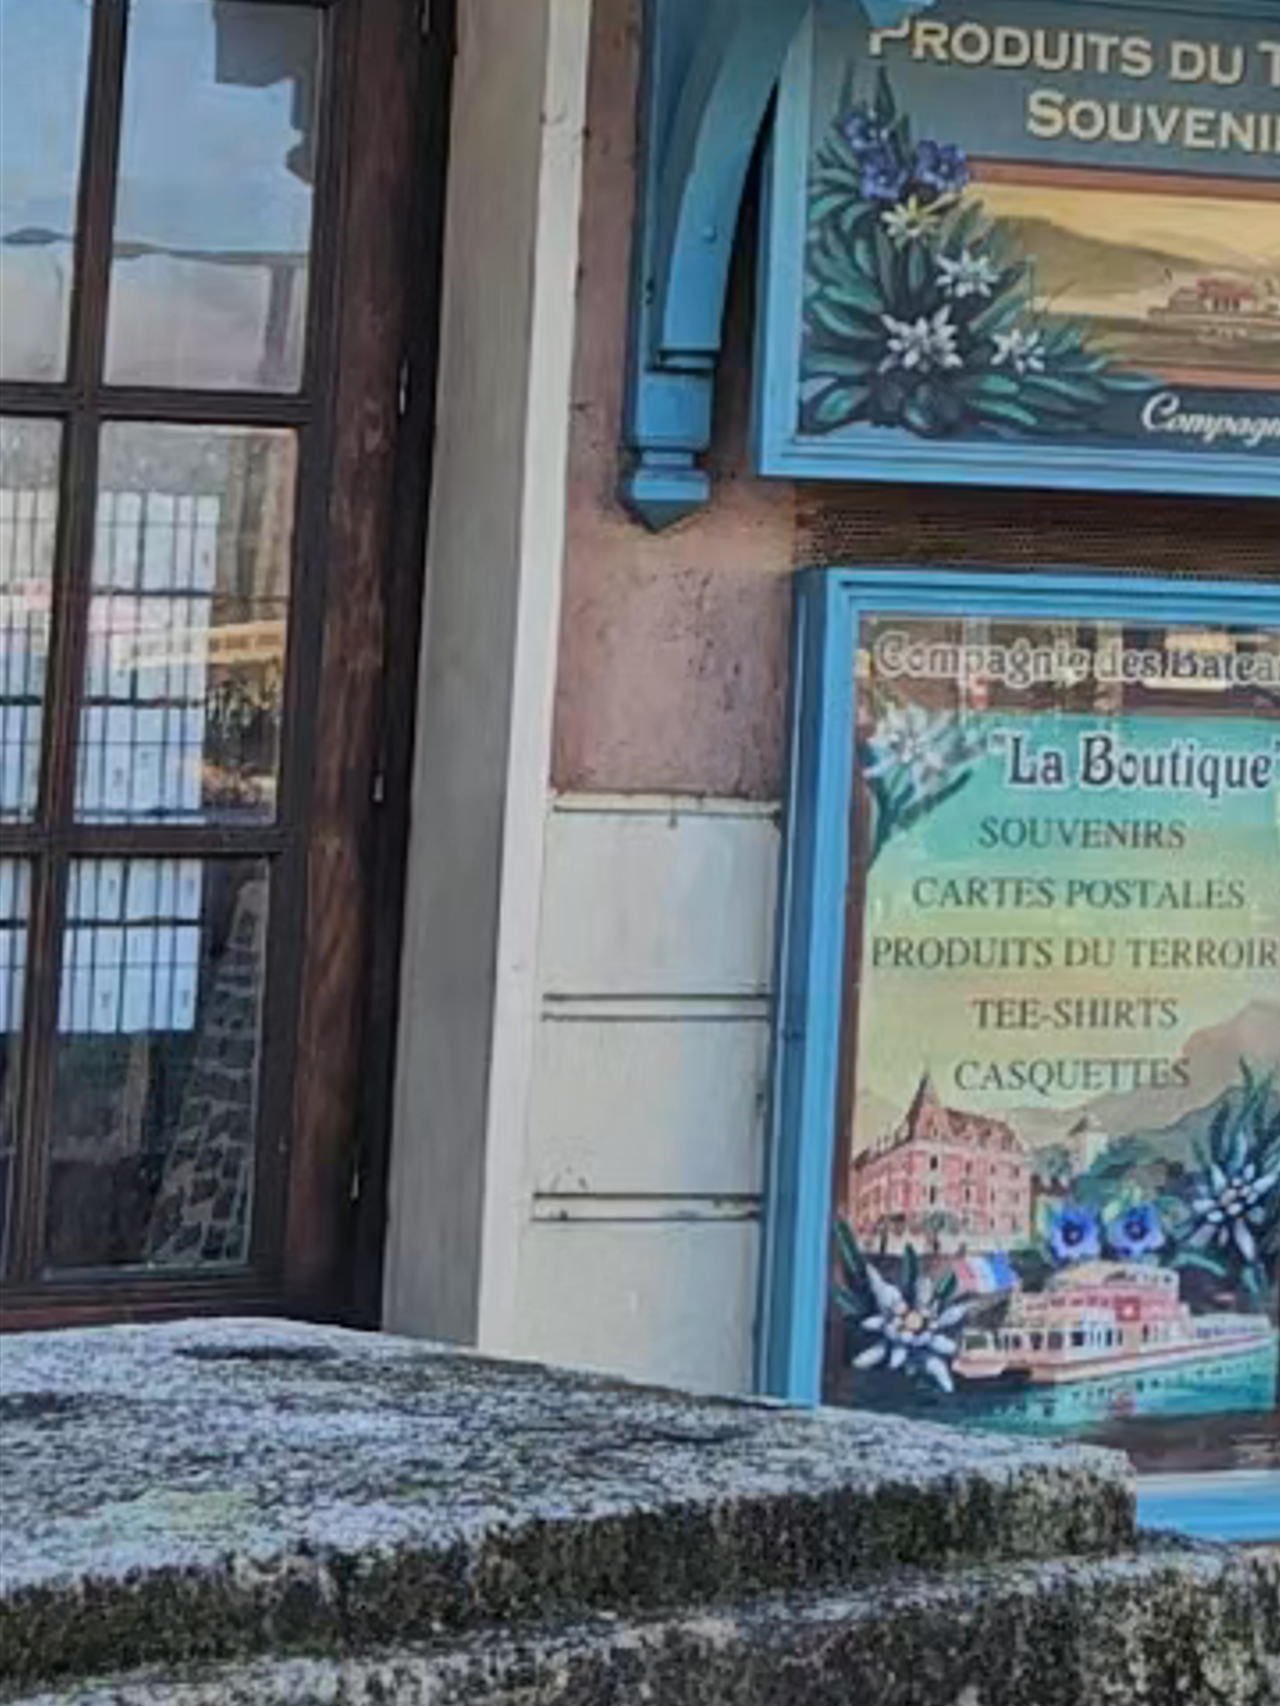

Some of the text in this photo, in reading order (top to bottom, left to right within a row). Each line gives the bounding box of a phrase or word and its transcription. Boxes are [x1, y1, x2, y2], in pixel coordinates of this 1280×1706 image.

[1170, 42, 1245, 84] DU
[874, 630, 1086, 686] Compagnie
[1096, 636, 1164, 680] des
[979, 817, 1187, 849] SOUVENIRS
[912, 878, 1246, 909] CARTES POSTALES
[872, 936, 1279, 968] PRODUITS DU TERROIR
[972, 998, 1179, 1029] TEE-SHIRTS
[954, 1059, 1191, 1093] CASQUETTES
